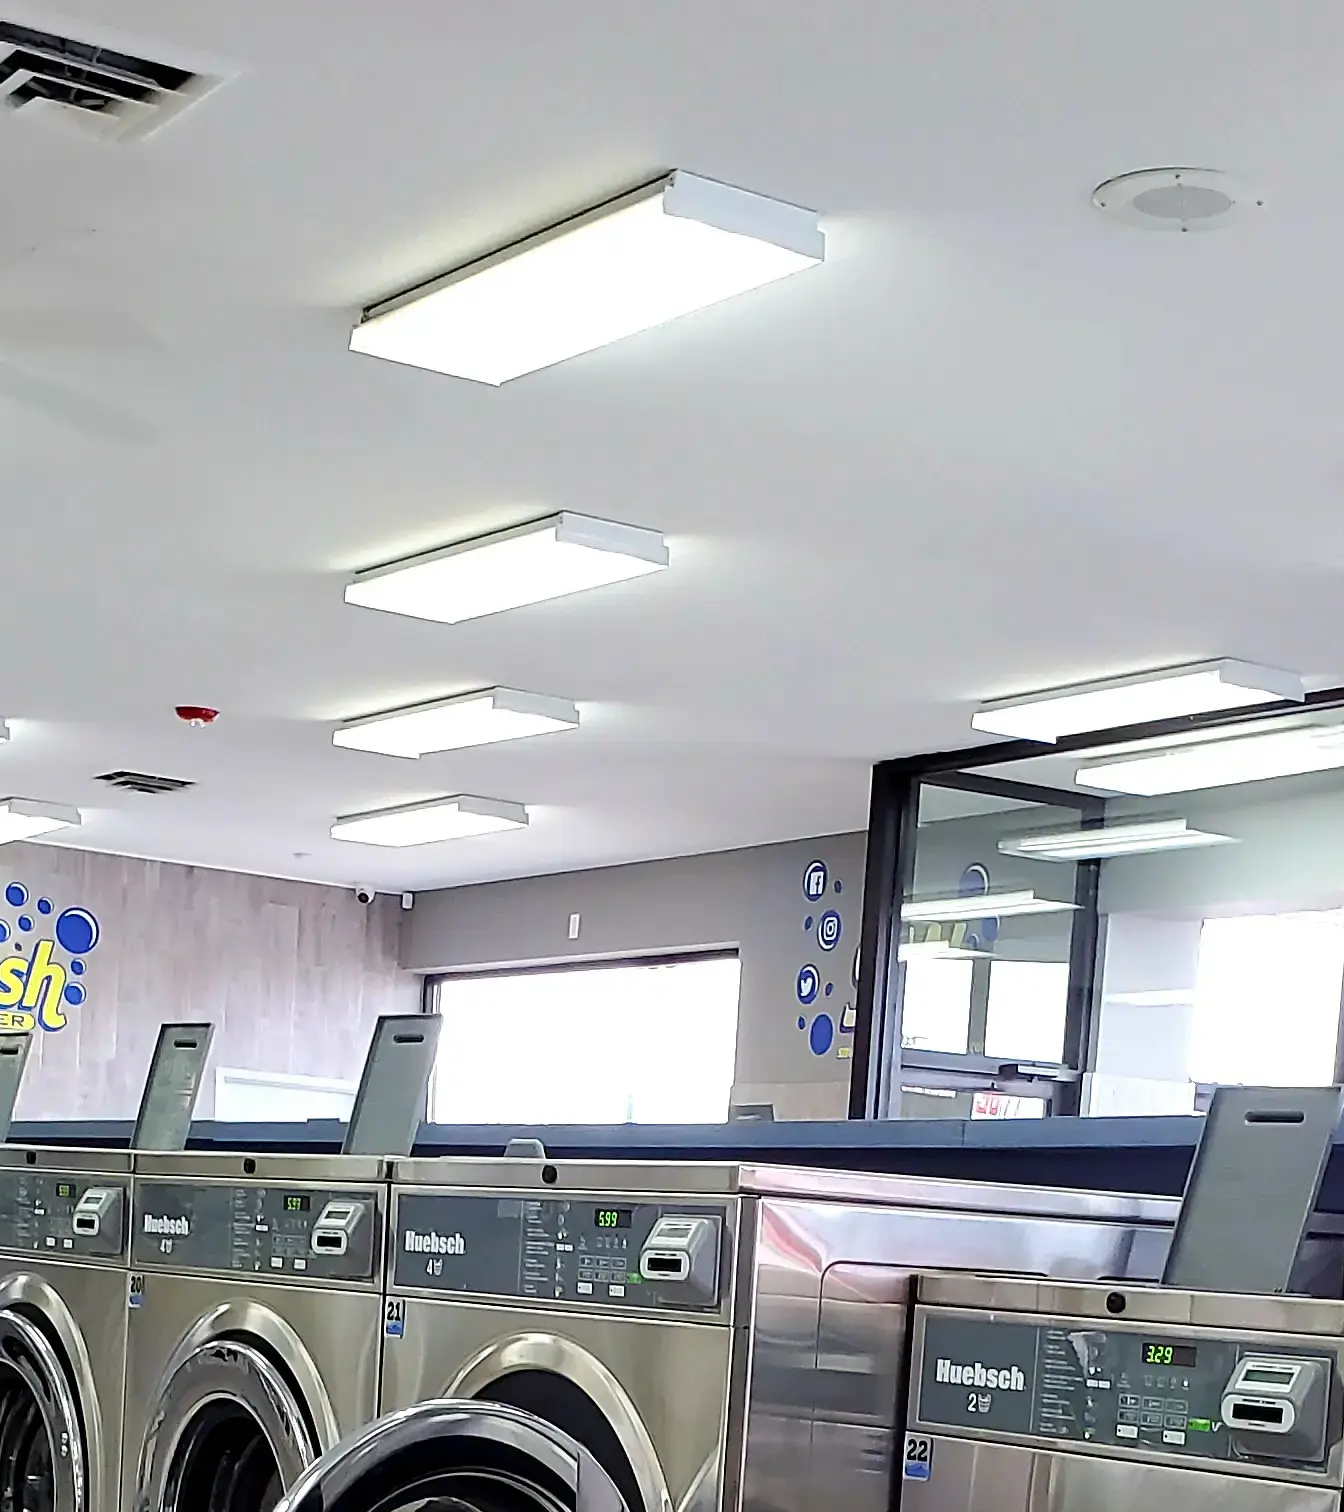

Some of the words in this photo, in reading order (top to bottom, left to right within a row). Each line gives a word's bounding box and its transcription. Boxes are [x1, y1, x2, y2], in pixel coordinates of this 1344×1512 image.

[404, 1230, 465, 1254] Huebsch
[130, 1275, 142, 1293] 20
[387, 1301, 401, 1321] 21
[936, 1358, 1025, 1391] Huebsch
[967, 1393, 977, 1412] 2
[907, 1439, 928, 1462] 22
